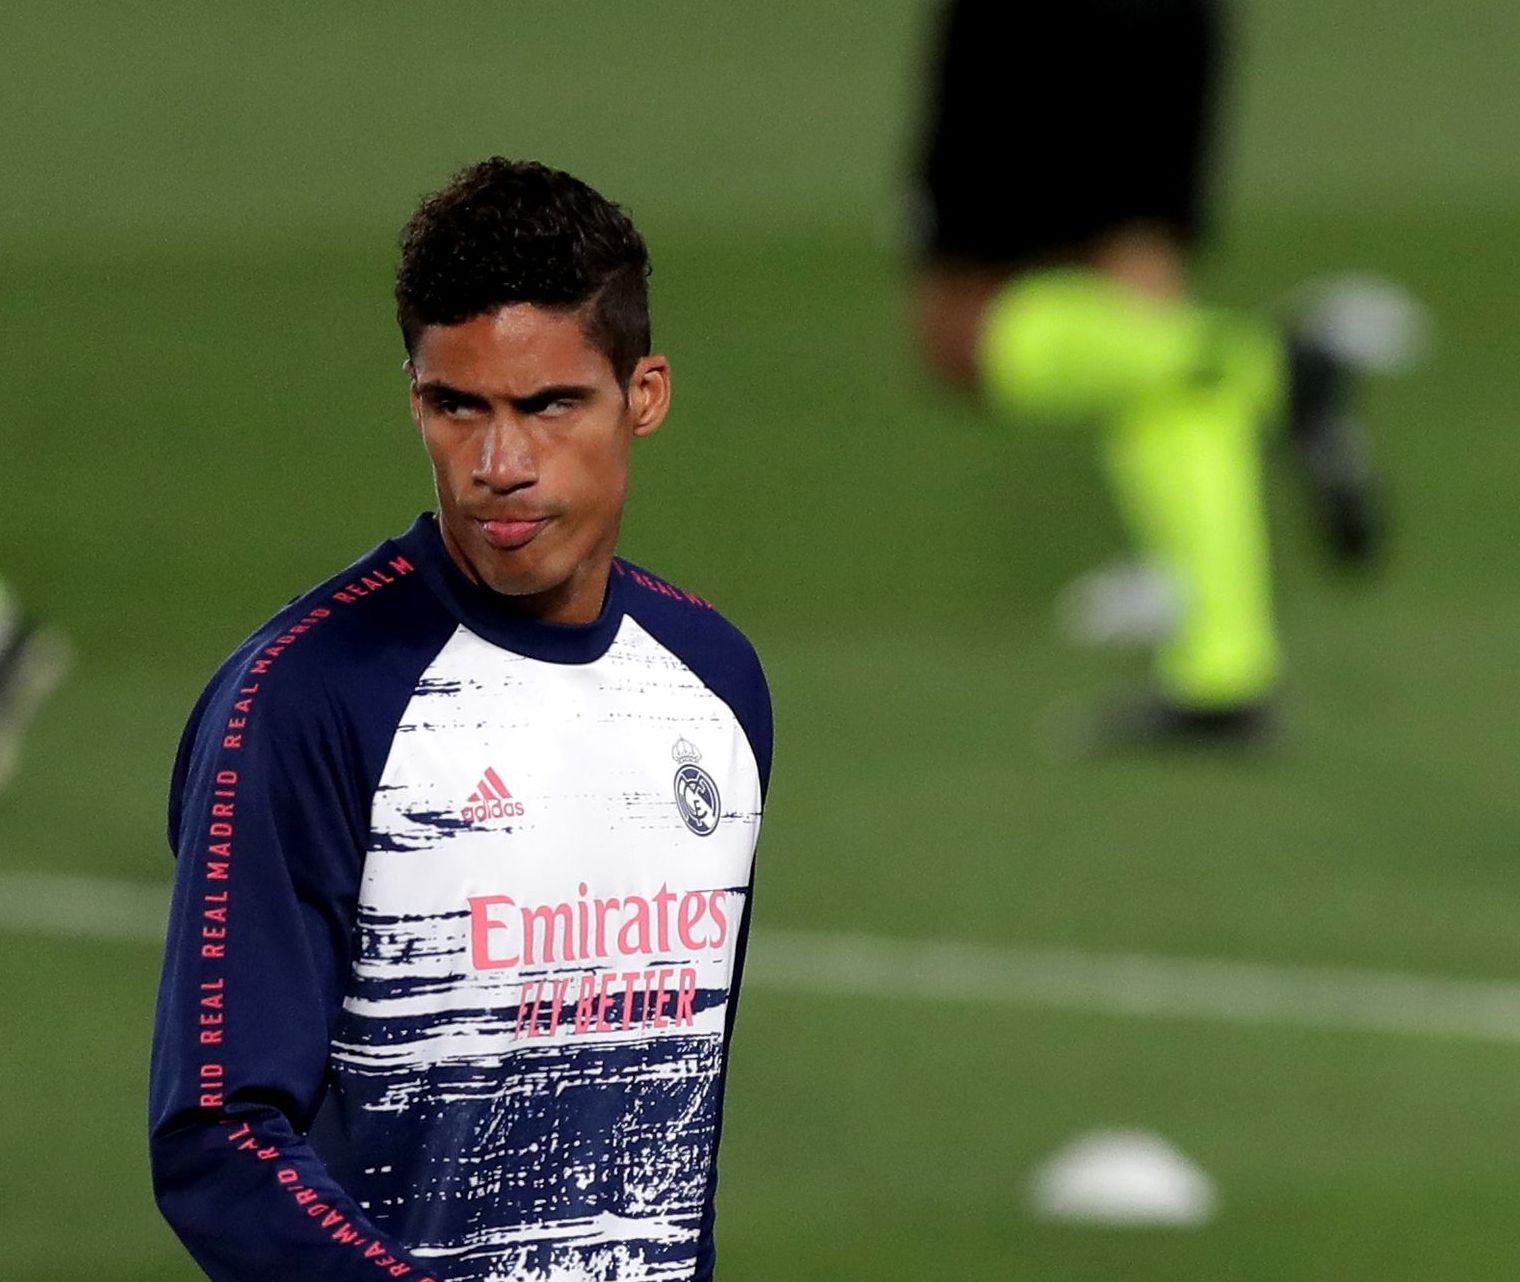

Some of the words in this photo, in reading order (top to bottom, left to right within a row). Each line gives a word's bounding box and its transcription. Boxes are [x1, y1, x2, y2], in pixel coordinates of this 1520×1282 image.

[332, 569, 395, 604] REAL
[250, 606, 332, 675] MADRID
[222, 684, 261, 749] REAL
[206, 768, 240, 881] MADRID
[460, 799, 525, 824] adidas
[200, 890, 230, 960] REAL
[466, 881, 728, 971] Emirates
[199, 978, 226, 1046] REAL
[514, 978, 570, 1040] FLY
[574, 967, 697, 1036] BETTER
[277, 1167, 358, 1244] MADRID
